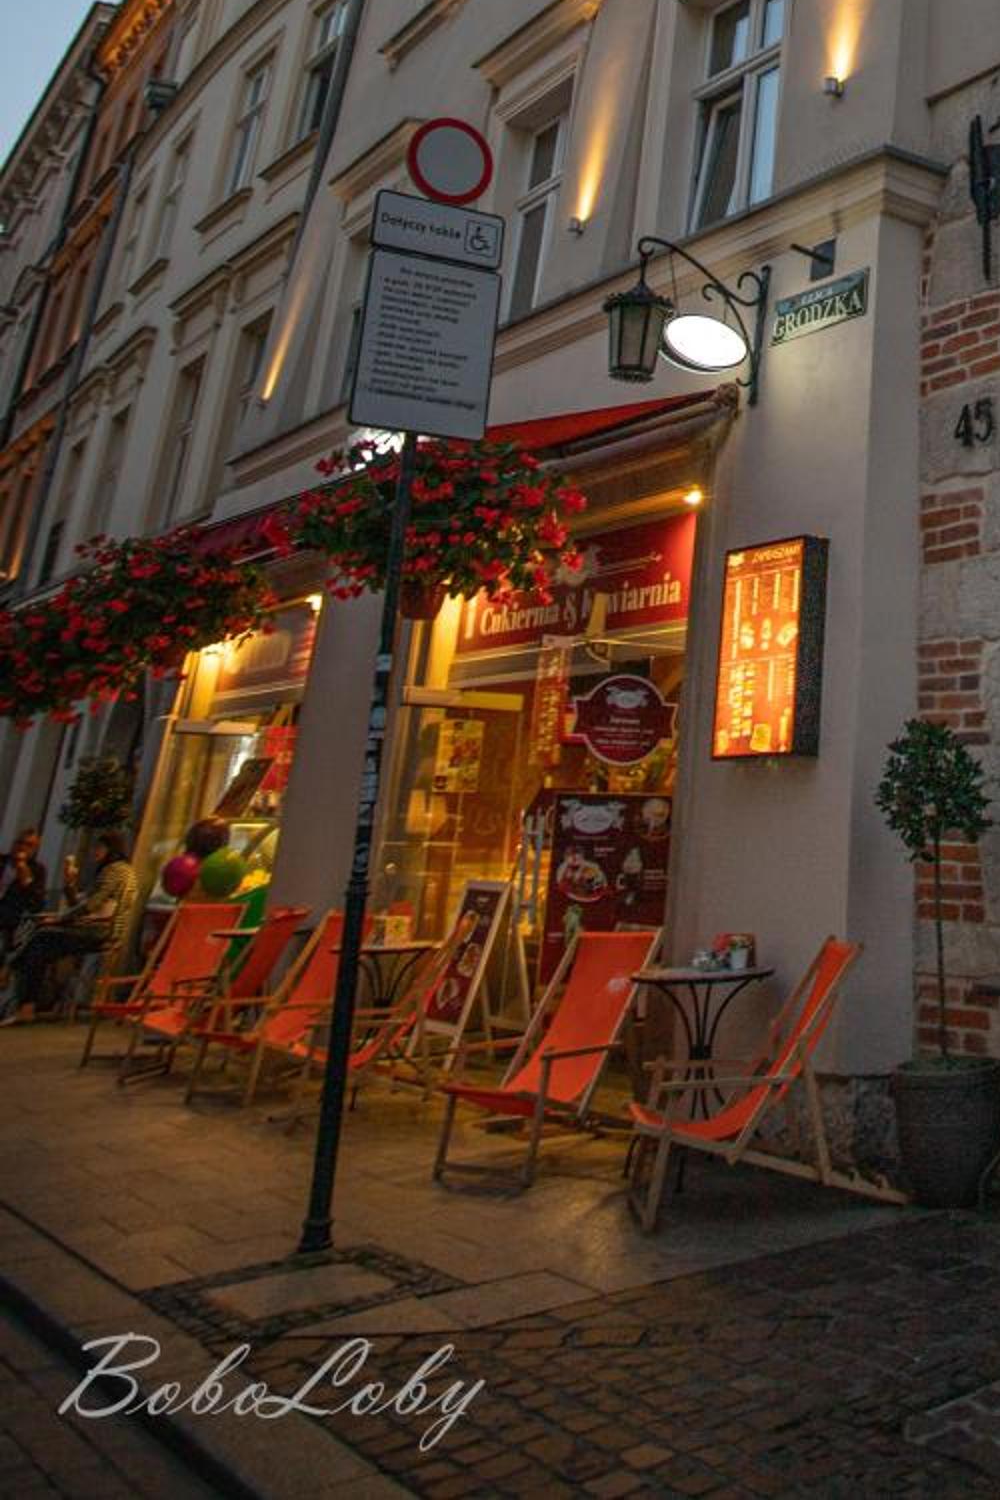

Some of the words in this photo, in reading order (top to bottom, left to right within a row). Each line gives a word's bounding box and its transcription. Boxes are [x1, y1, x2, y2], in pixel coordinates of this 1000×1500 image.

[771, 290, 864, 339] GRODZKA
[953, 396, 993, 448] 45
[581, 571, 681, 618] Kwiarnia
